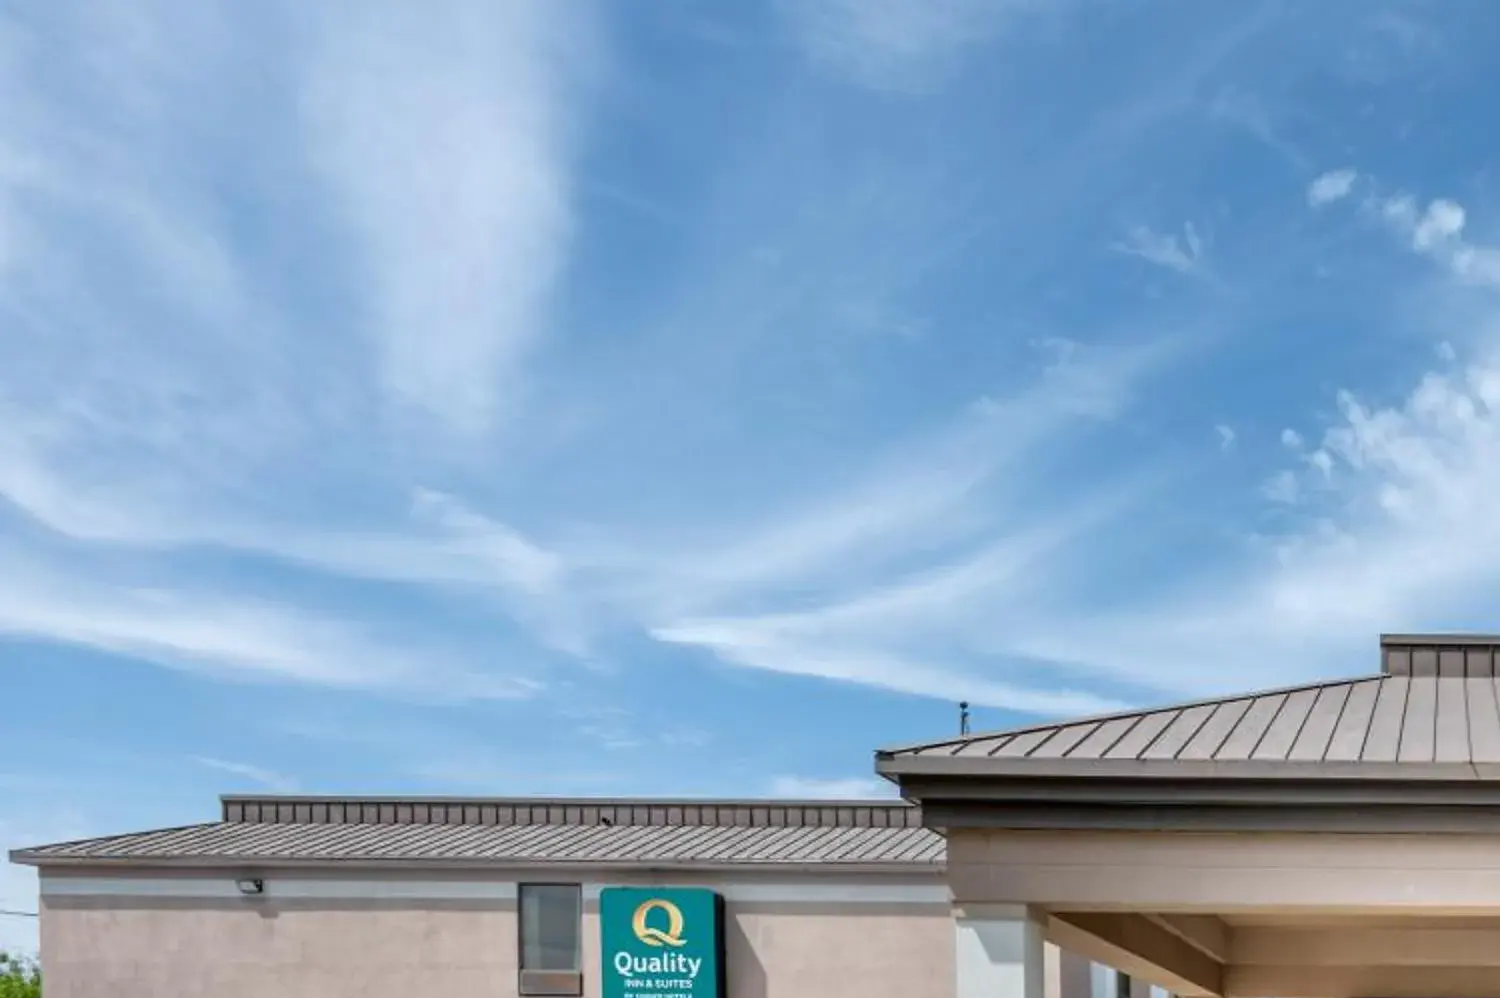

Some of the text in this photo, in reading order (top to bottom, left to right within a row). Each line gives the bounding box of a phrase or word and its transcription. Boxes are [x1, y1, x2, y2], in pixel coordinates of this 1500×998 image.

[632, 898, 688, 946] Q
[614, 951, 702, 978] Quality
[624, 979, 693, 989] INN & SUITES
